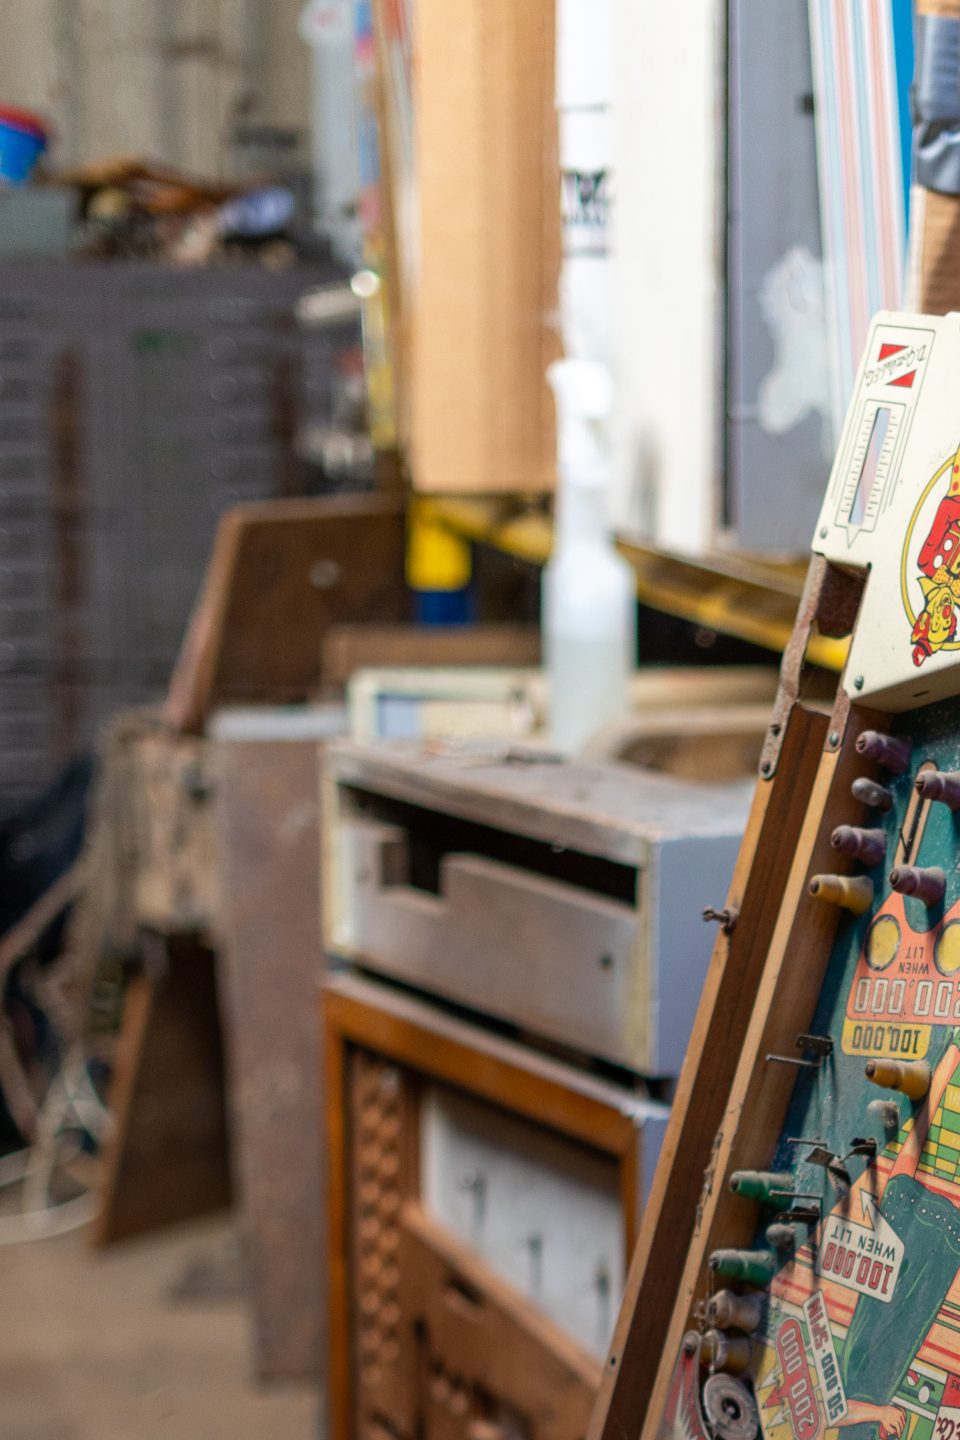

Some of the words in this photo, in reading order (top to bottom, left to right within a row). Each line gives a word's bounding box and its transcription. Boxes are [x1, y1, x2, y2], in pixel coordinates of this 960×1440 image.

[905, 946, 924, 959] LIT
[898, 962, 929, 975] WHEN
[852, 1025, 921, 1054] 100,000
[830, 1224, 852, 1247] LIT
[857, 1235, 896, 1262] WHEN
[822, 1242, 893, 1294] 100,000
